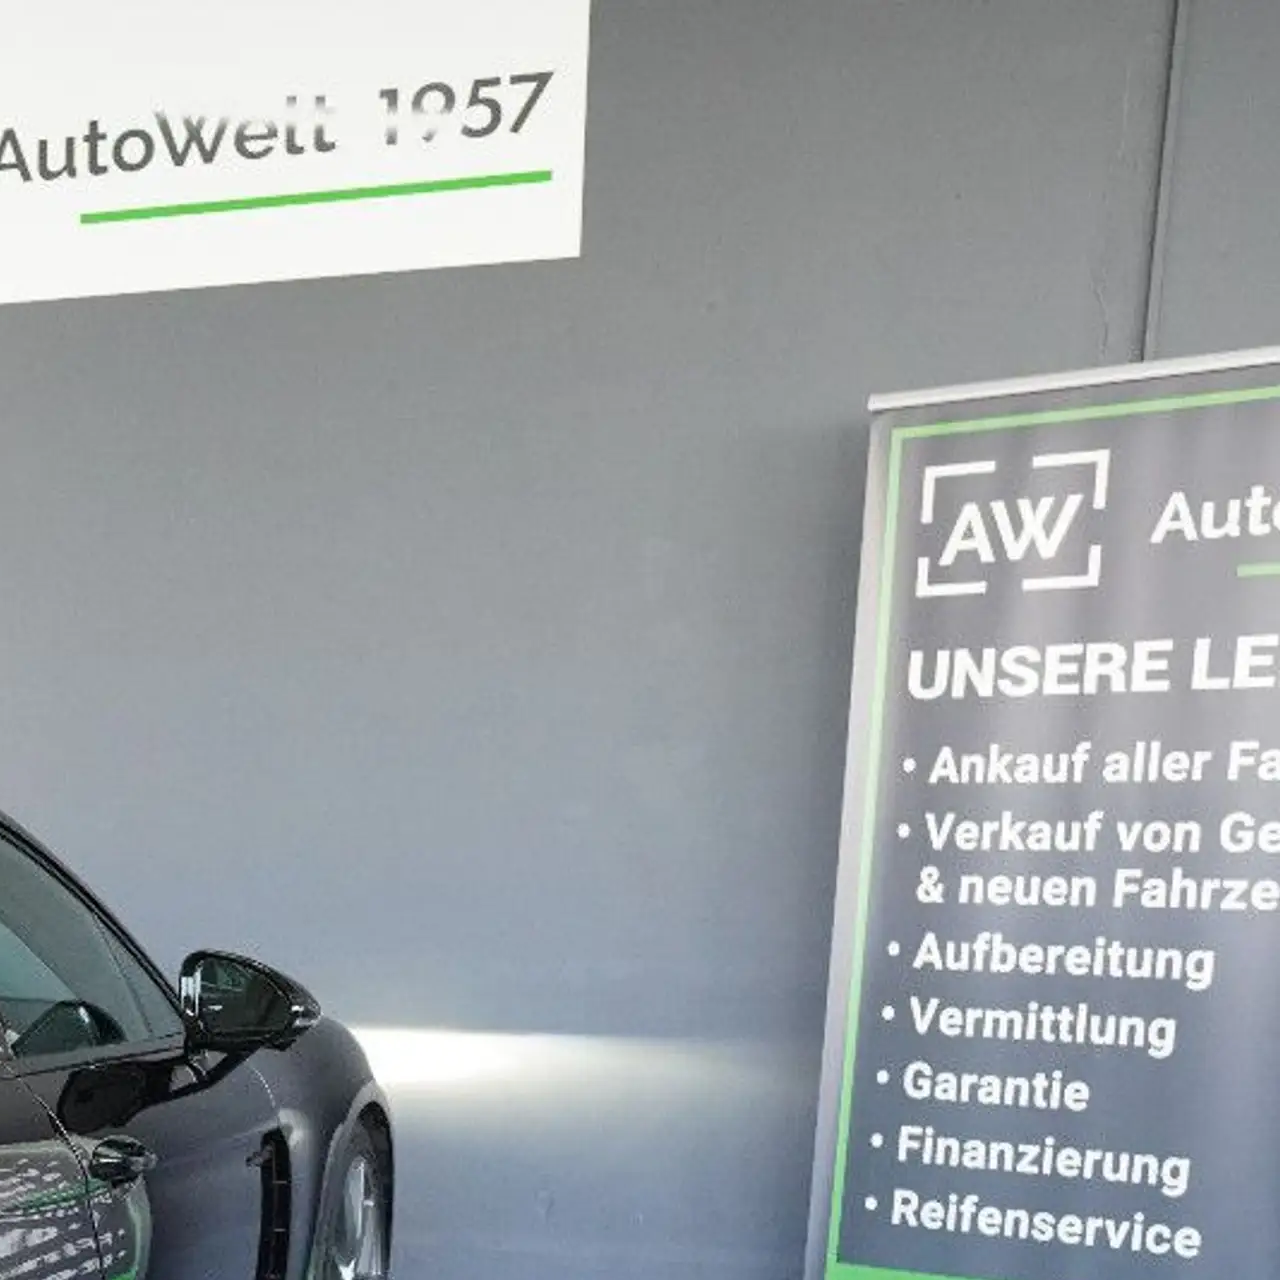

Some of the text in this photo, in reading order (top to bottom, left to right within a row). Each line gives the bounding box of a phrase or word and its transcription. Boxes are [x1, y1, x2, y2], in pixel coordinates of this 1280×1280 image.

[378, 71, 554, 147] 1957
[939, 493, 1085, 566] AW
[1149, 485, 1280, 543] Aut
[907, 634, 1280, 700] UNSERE LE
[928, 740, 1280, 784] Ankauf aller Fa
[924, 811, 1280, 854] Verkauf von Ge
[916, 865, 1280, 912] & neuen Fahrze
[912, 932, 1215, 991] Aufbereitung
[909, 996, 1177, 1059] Vermittlung
[902, 1060, 1090, 1112] Garantie
[897, 1125, 1191, 1198] Finanzierung
[891, 1188, 1203, 1259] Reifenservice
